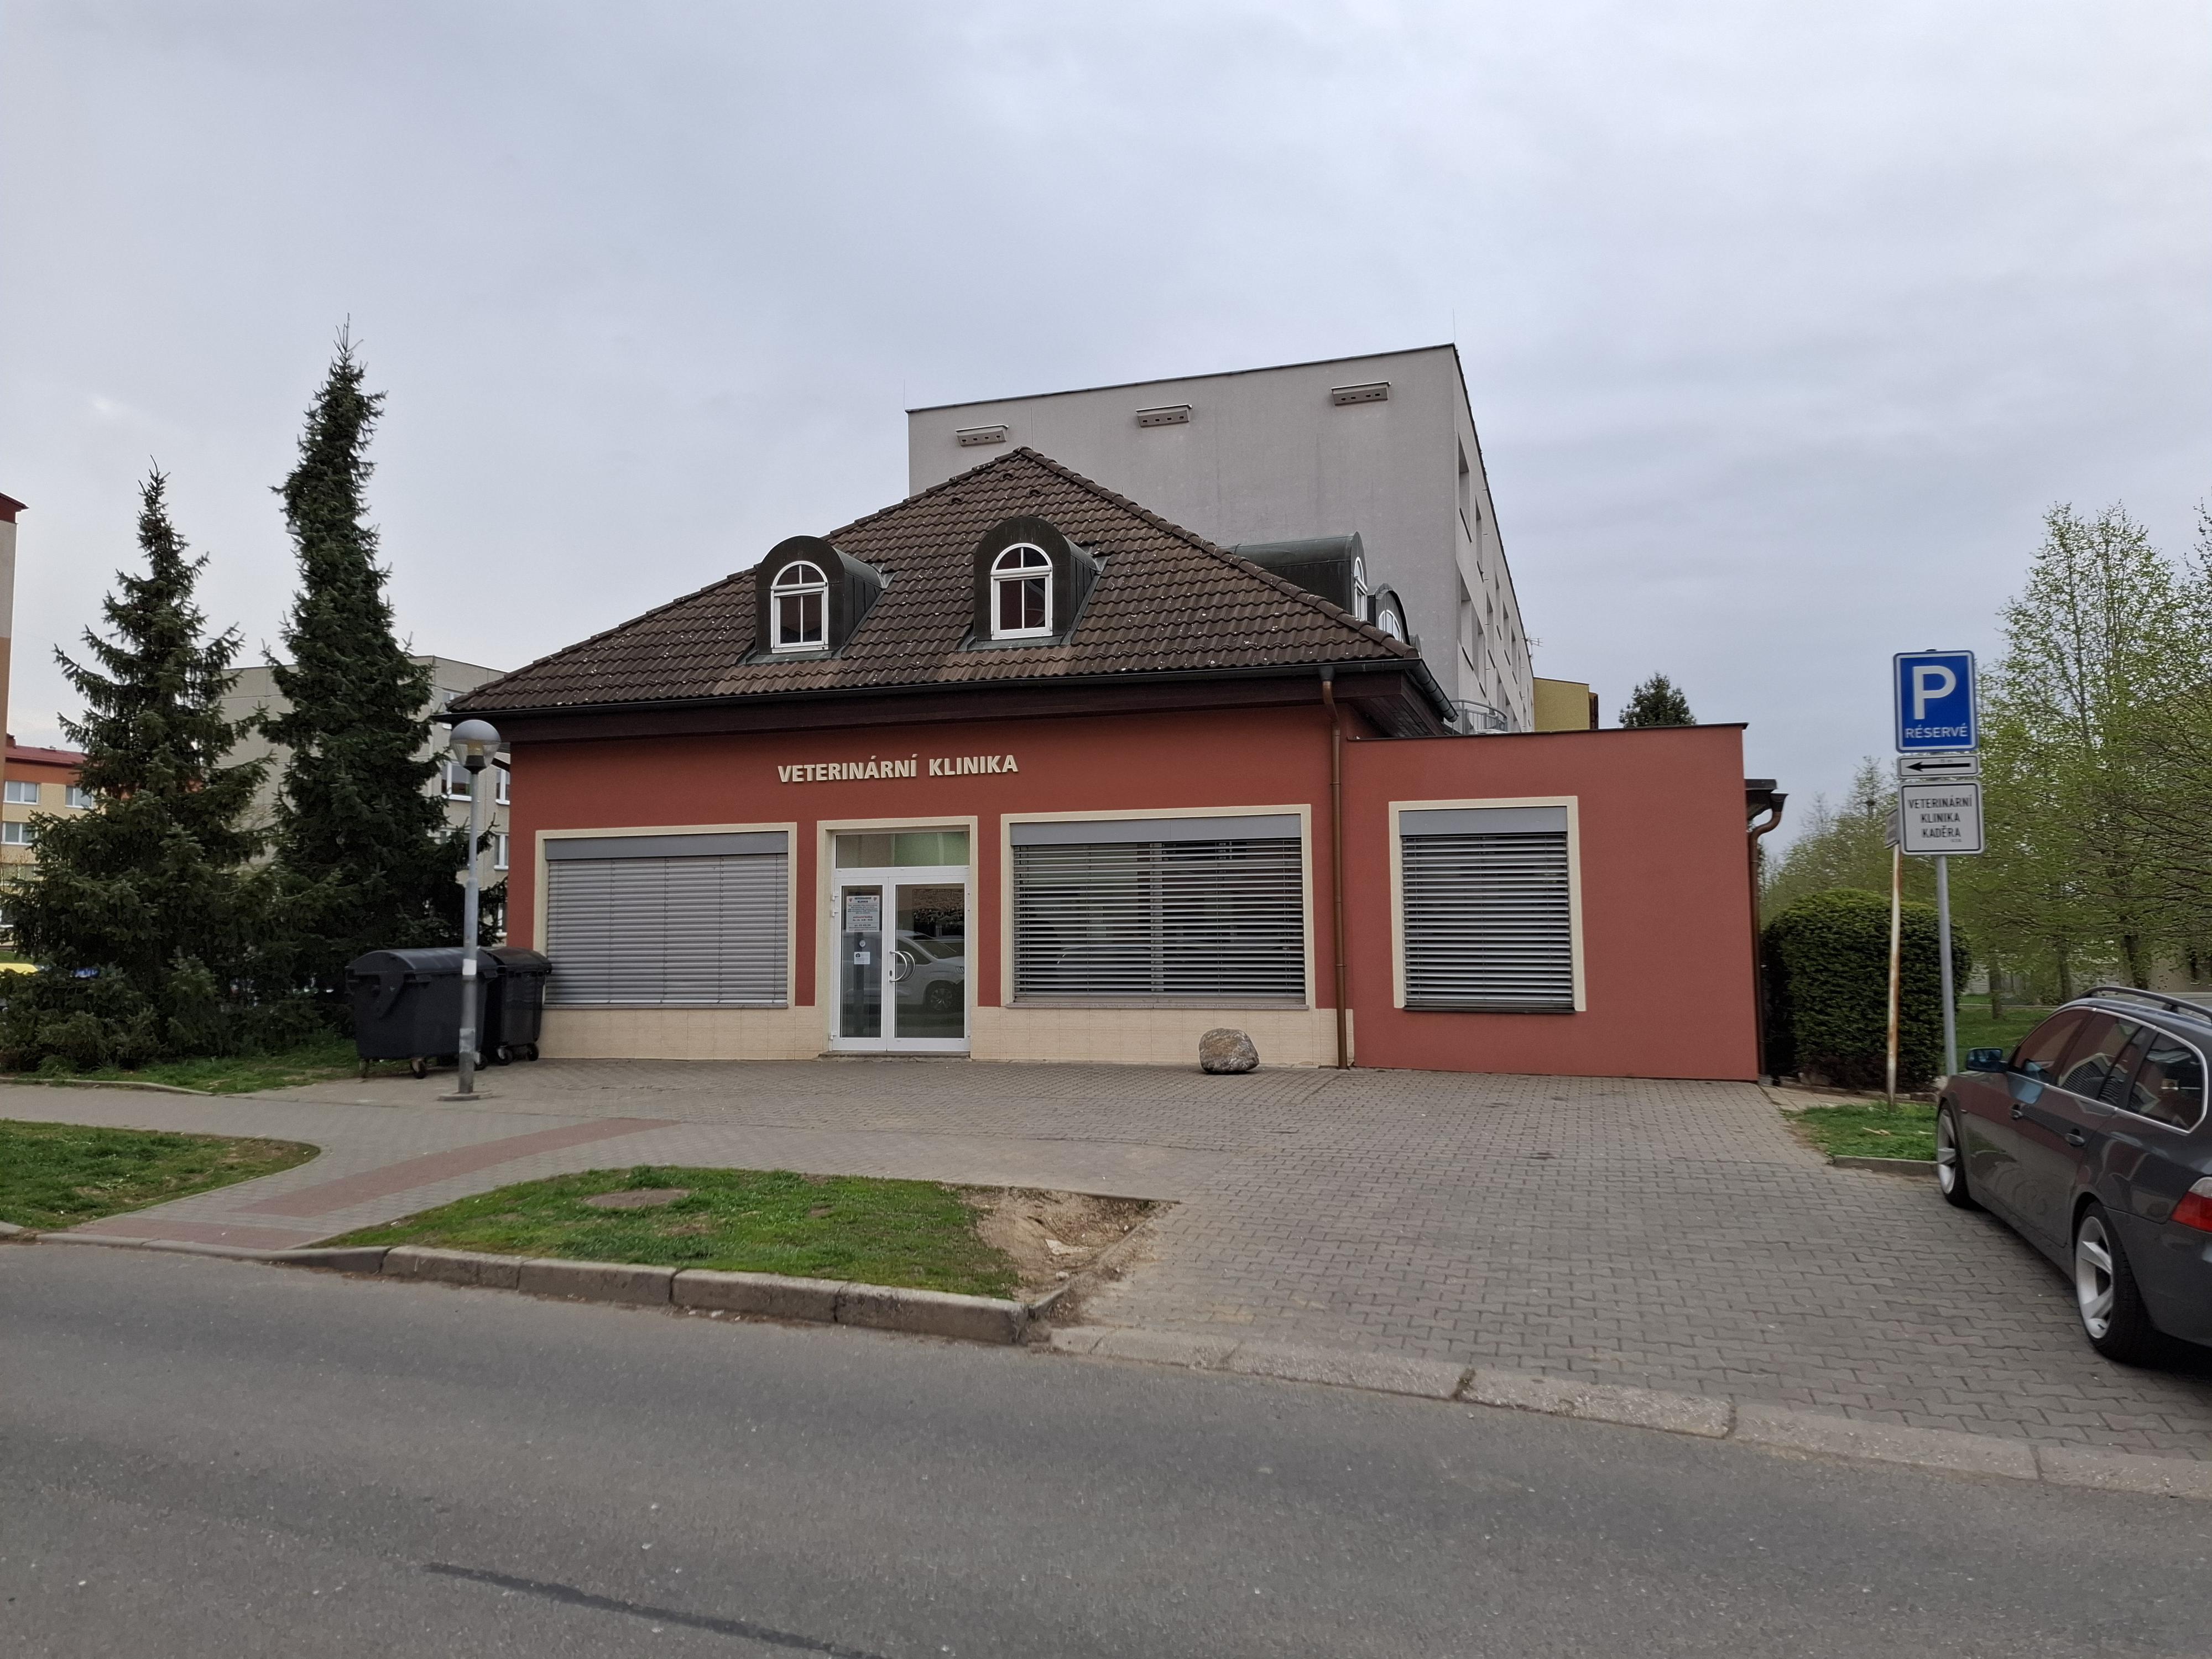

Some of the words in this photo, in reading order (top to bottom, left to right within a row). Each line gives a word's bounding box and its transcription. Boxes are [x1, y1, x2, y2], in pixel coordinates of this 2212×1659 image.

[1913, 665, 1957, 719] P
[1905, 723, 1968, 738] RÉSERVÉ
[778, 754, 918, 782] VETERINÁRNÍ
[929, 755, 1019, 776] KLINIKA
[1908, 795, 1972, 808] VETERINÁRNÍ
[1920, 813, 1960, 823] KLINIKA
[1921, 825, 1961, 838] KADĚRA
